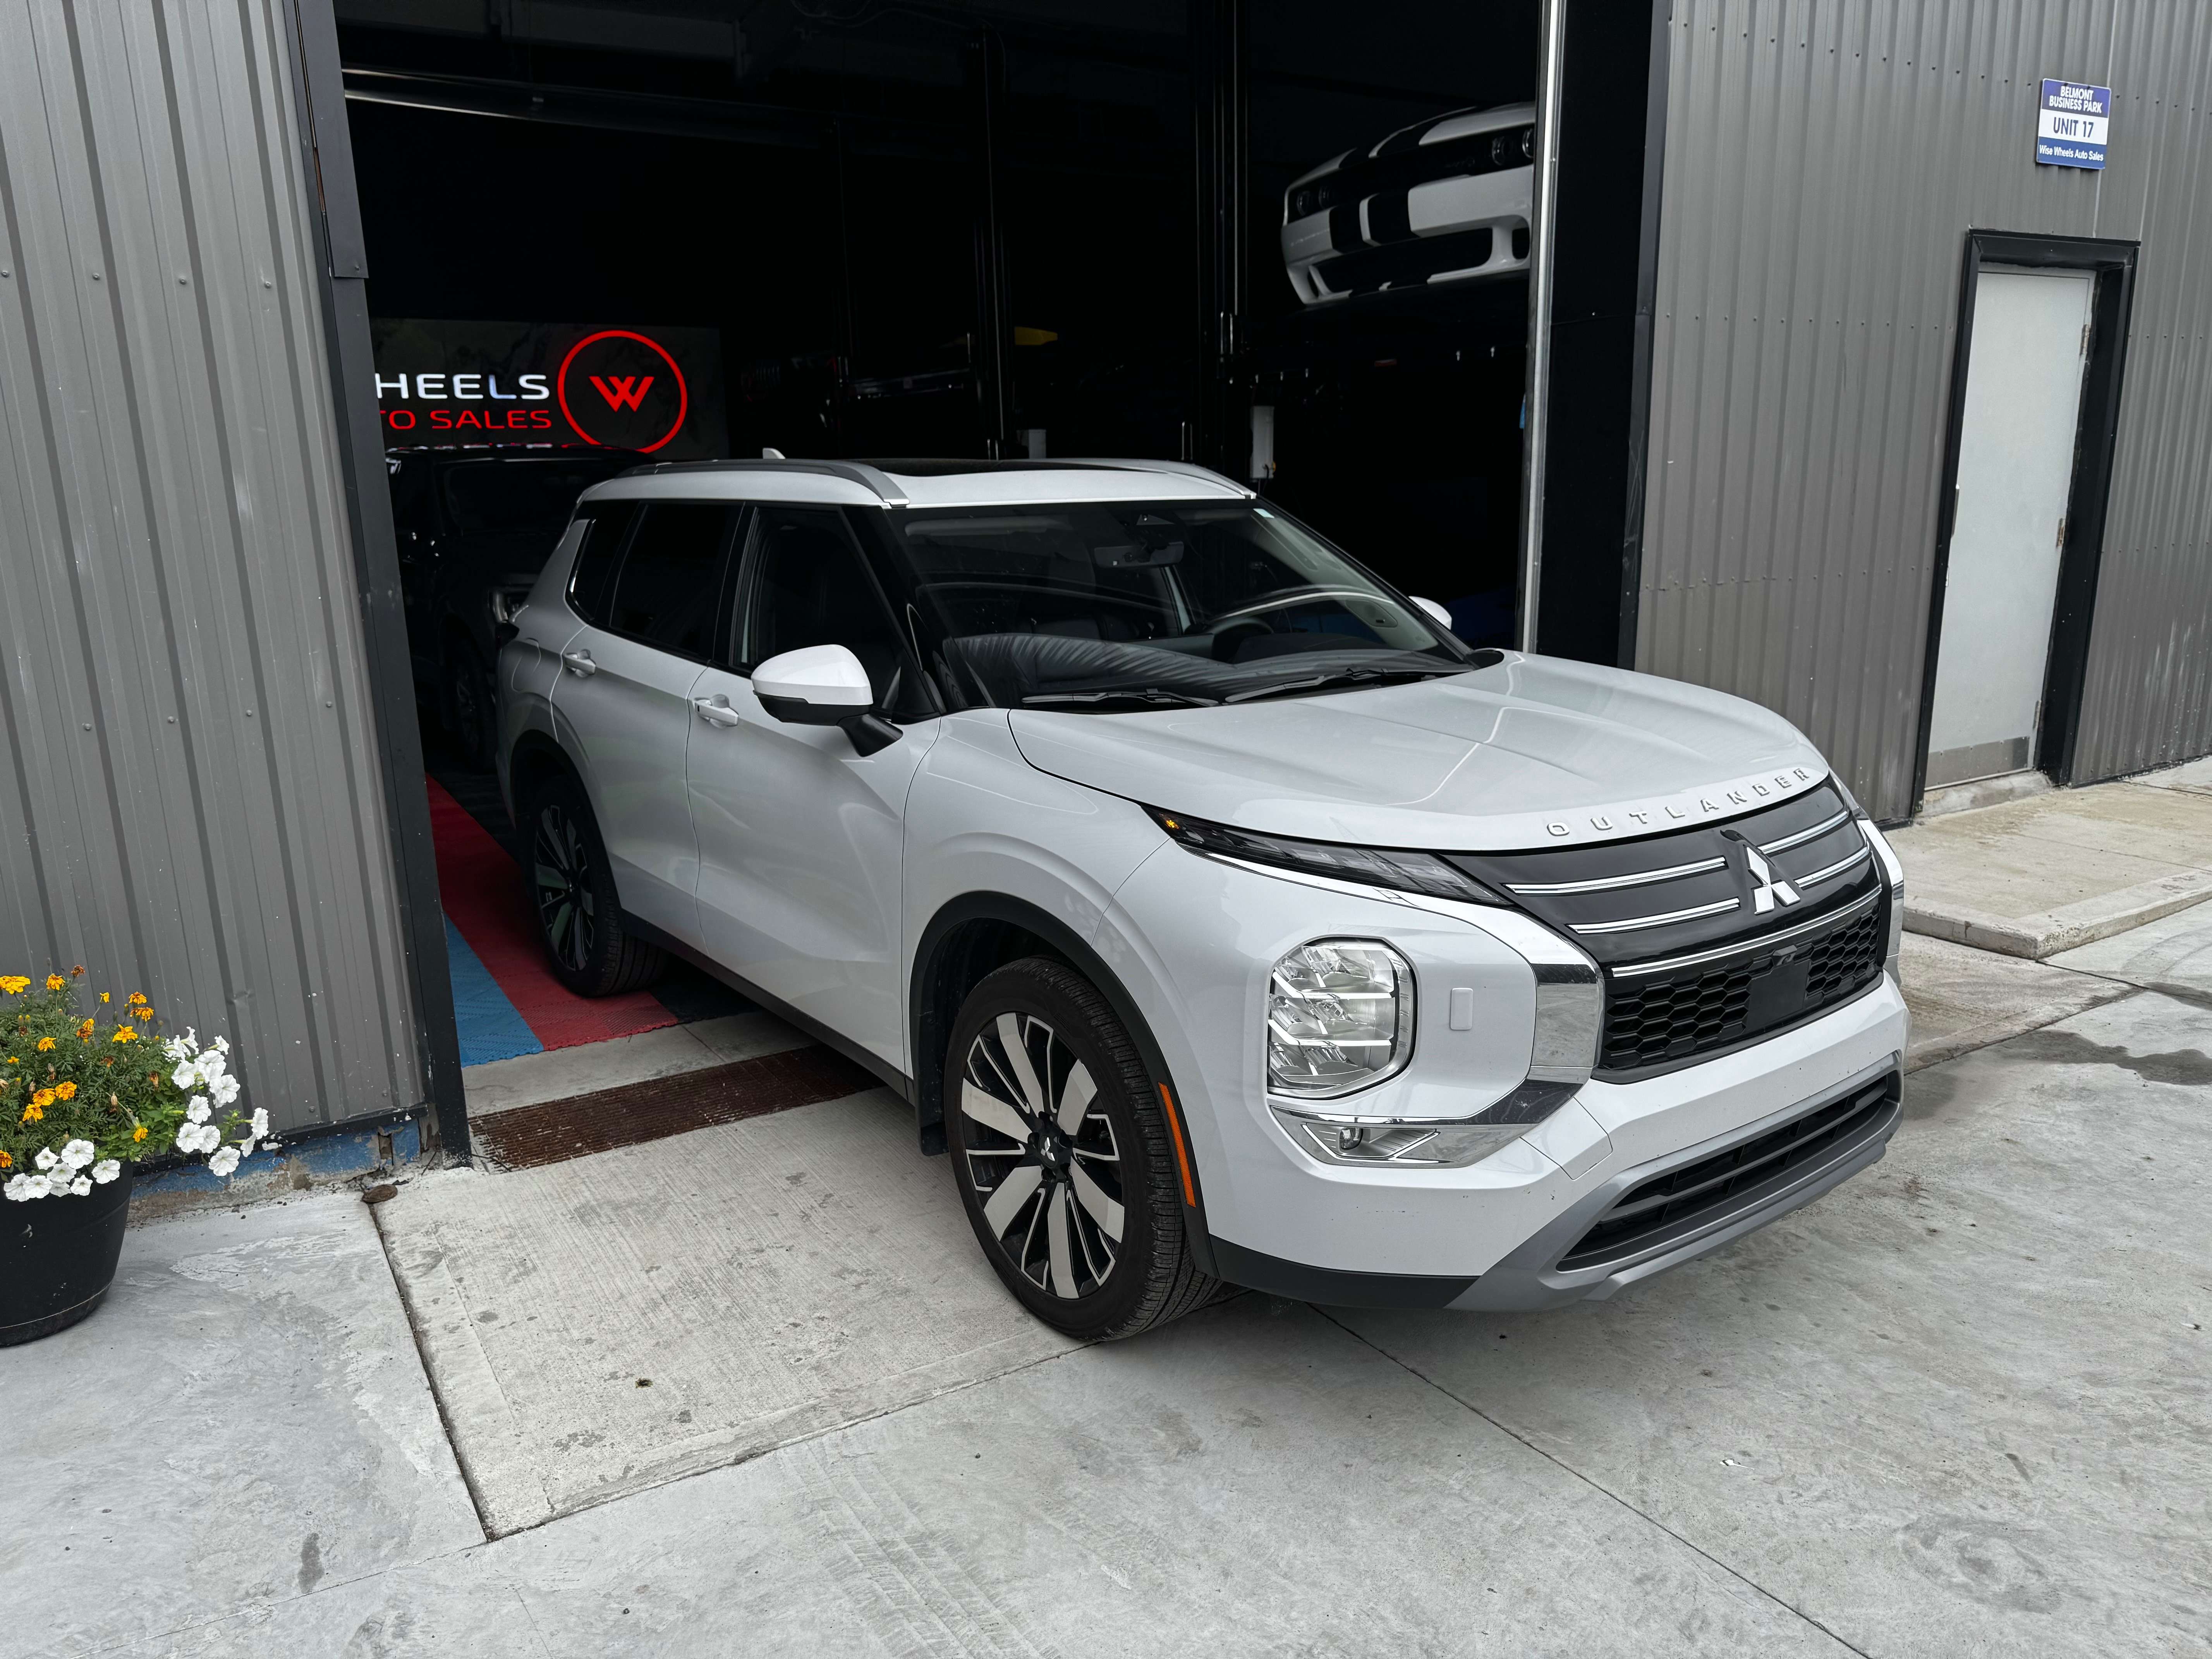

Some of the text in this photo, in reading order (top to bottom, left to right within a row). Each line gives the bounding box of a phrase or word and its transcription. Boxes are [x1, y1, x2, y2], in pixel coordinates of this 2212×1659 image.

[2060, 86, 2094, 100] BELMONT
[2049, 95, 2102, 113] BUSINESS PARK
[2053, 117, 2094, 137] UNIT 17
[2039, 144, 2104, 161] Wise Wheels Auto Sales
[380, 409, 552, 430] O SALES
[1547, 768, 1810, 836] OUTLANDER
